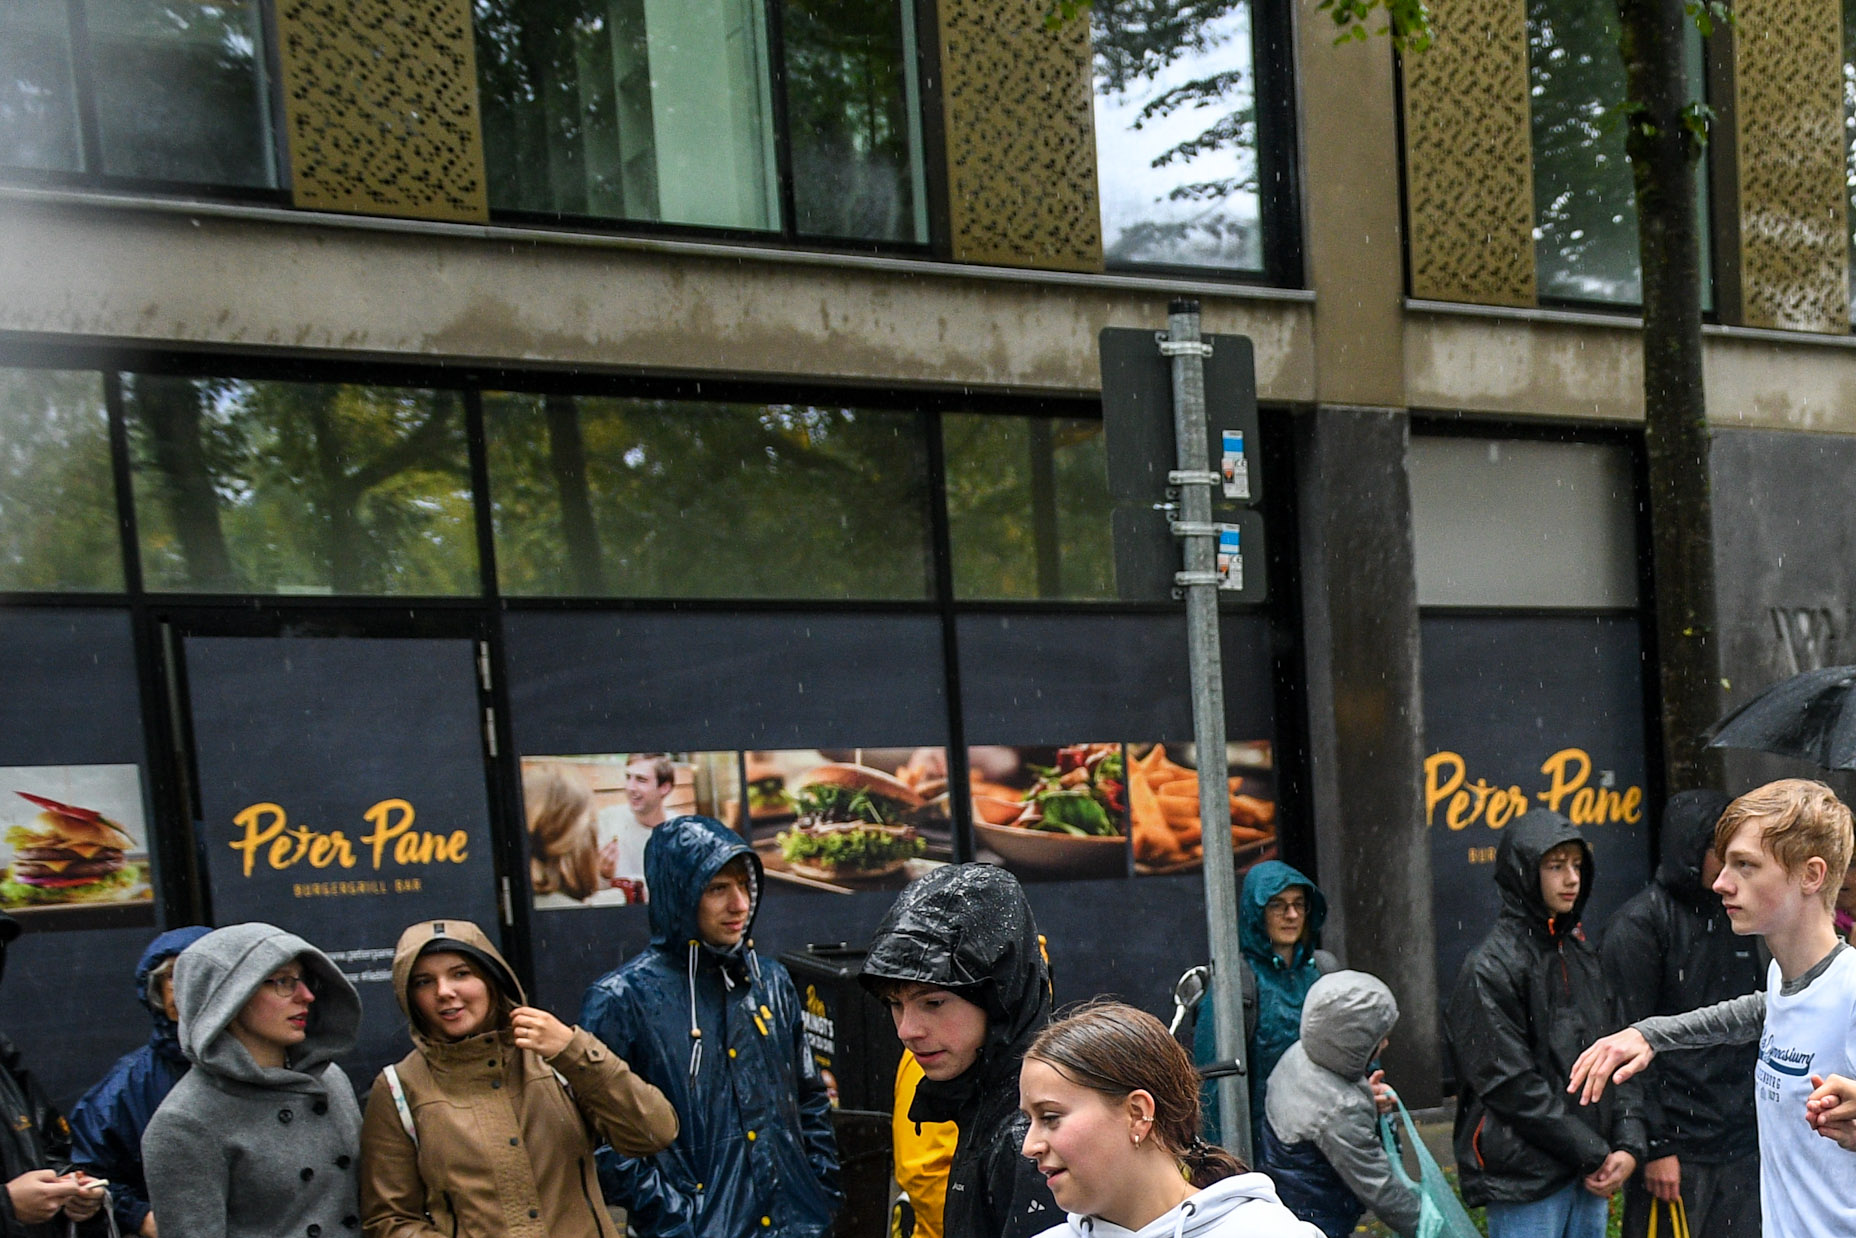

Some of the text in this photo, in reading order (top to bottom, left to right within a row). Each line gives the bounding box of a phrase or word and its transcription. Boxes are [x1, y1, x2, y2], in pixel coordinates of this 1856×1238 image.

[1424, 747, 1642, 831] Peter Pane
[228, 798, 468, 878] Peter Pane
[293, 878, 421, 898] BURGERGRILL BAR
